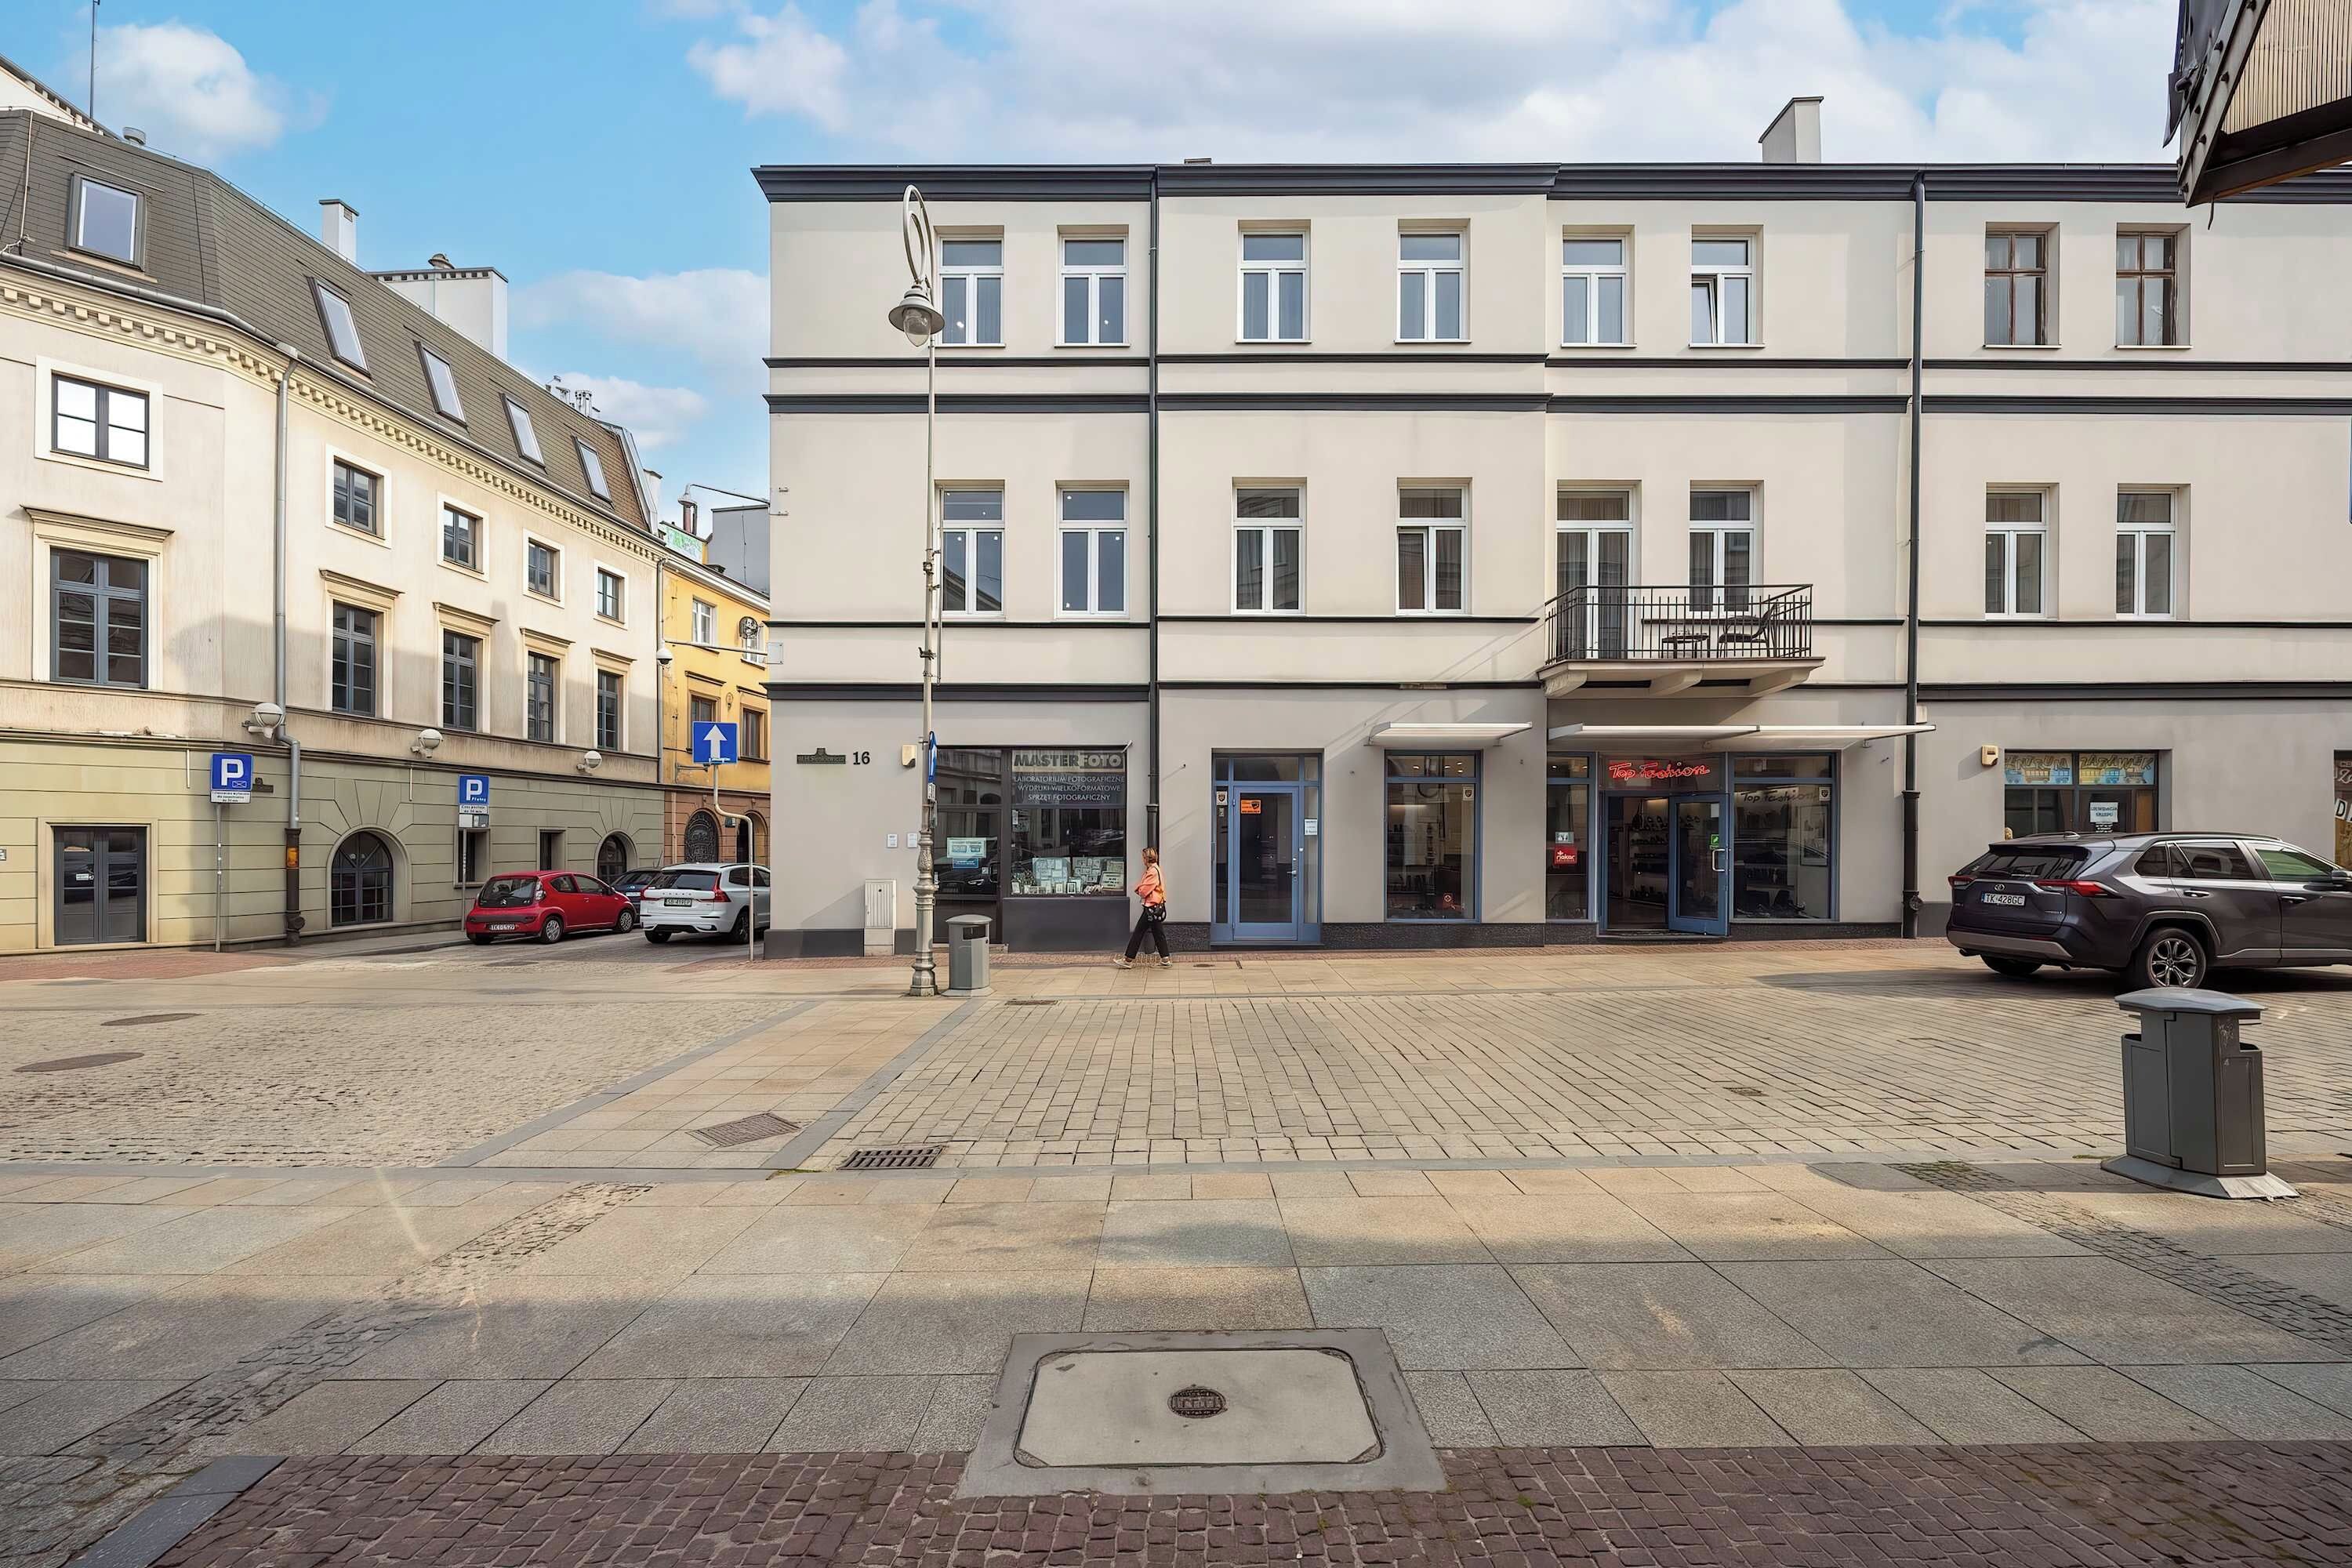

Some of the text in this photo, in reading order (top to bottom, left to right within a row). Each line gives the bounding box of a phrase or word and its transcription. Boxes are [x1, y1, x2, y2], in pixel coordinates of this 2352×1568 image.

[853, 751, 870, 765] 16
[221, 758, 244, 786] P
[1609, 762, 1635, 781] Top
[466, 779, 483, 801] P
[1986, 894, 2024, 905] TK 428GC
